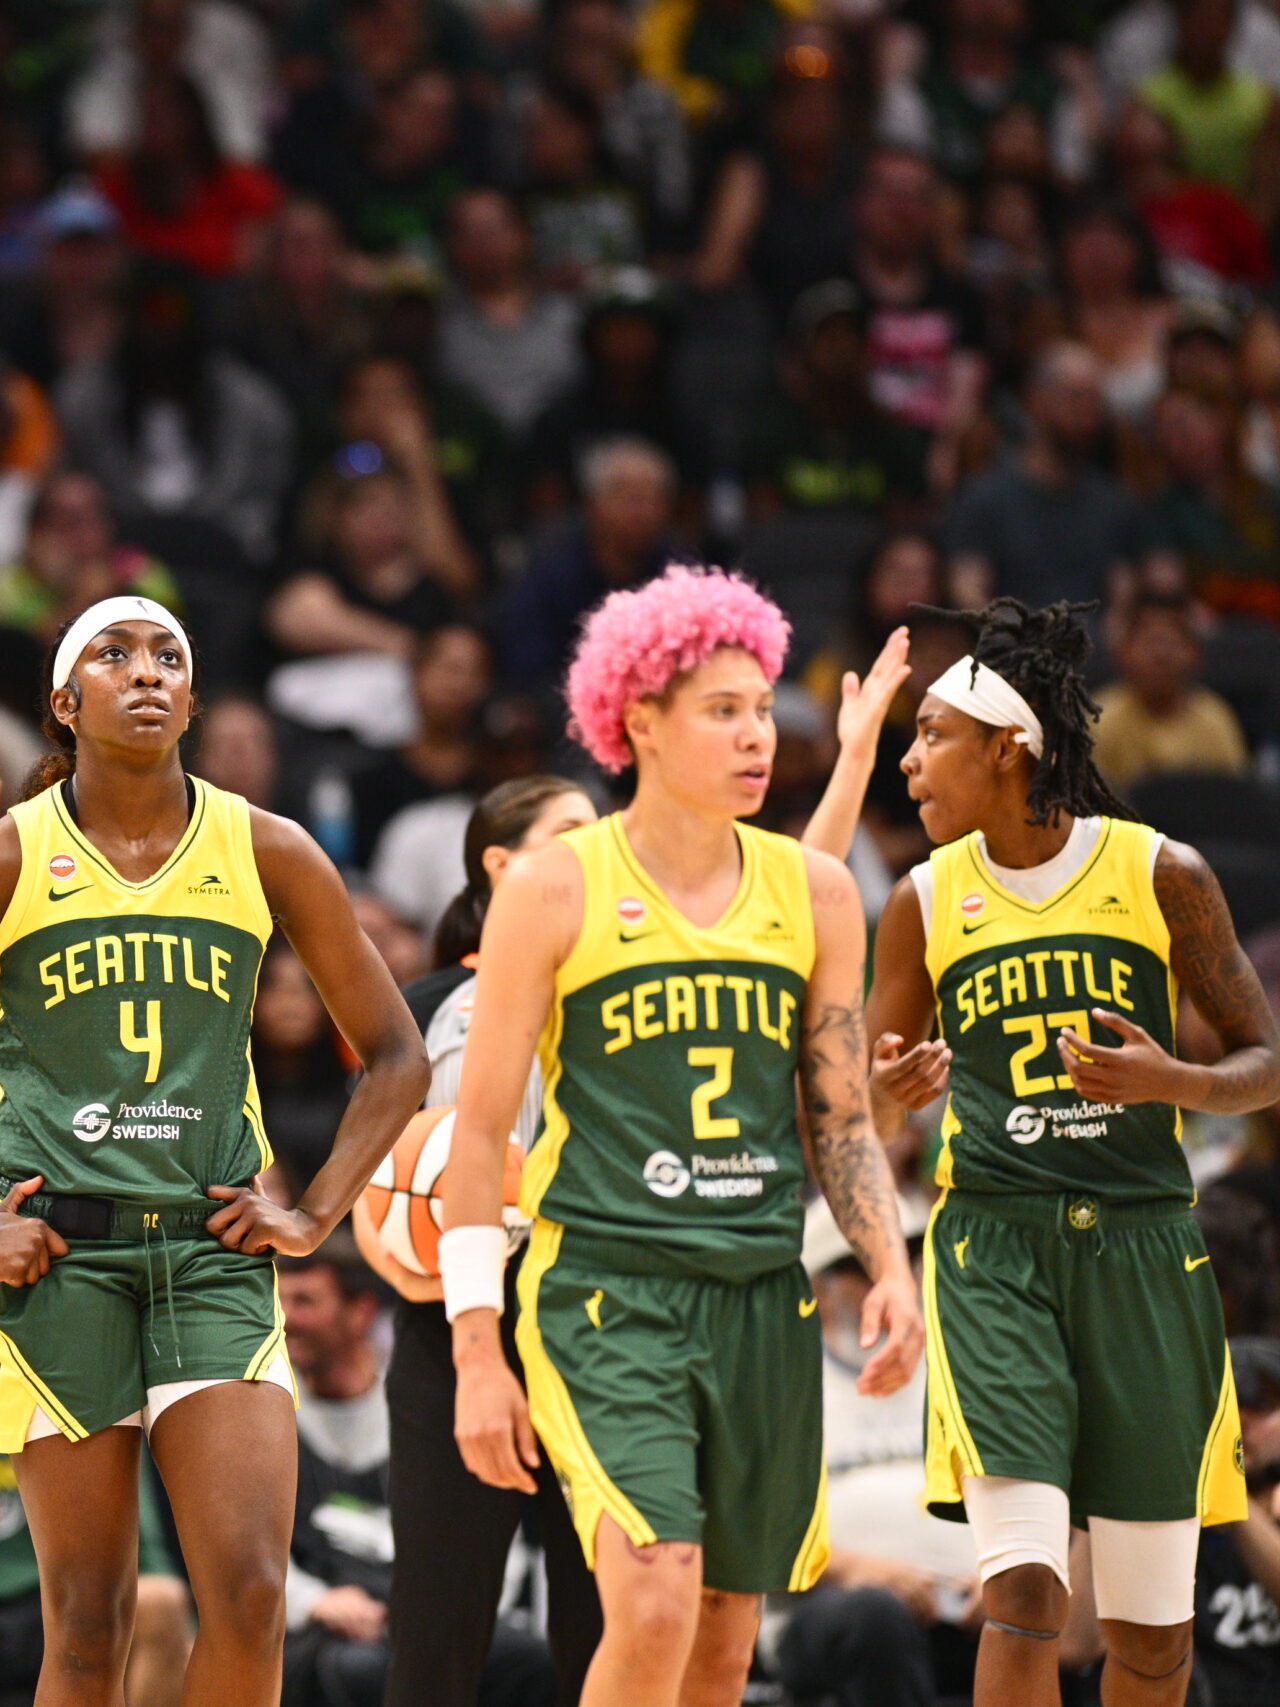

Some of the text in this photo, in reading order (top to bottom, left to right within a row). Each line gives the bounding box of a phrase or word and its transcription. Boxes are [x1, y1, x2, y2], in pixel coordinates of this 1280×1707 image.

[187, 886, 231, 896] SYMETRA
[39, 932, 232, 1010] SEATTLE
[956, 950, 1135, 1034] SEATTLE
[119, 1000, 162, 1083] 4
[601, 973, 796, 1055] SEATTLE
[112, 1124, 180, 1141] SWEDISH
[117, 1099, 202, 1121] Providence
[687, 1047, 740, 1140] 2
